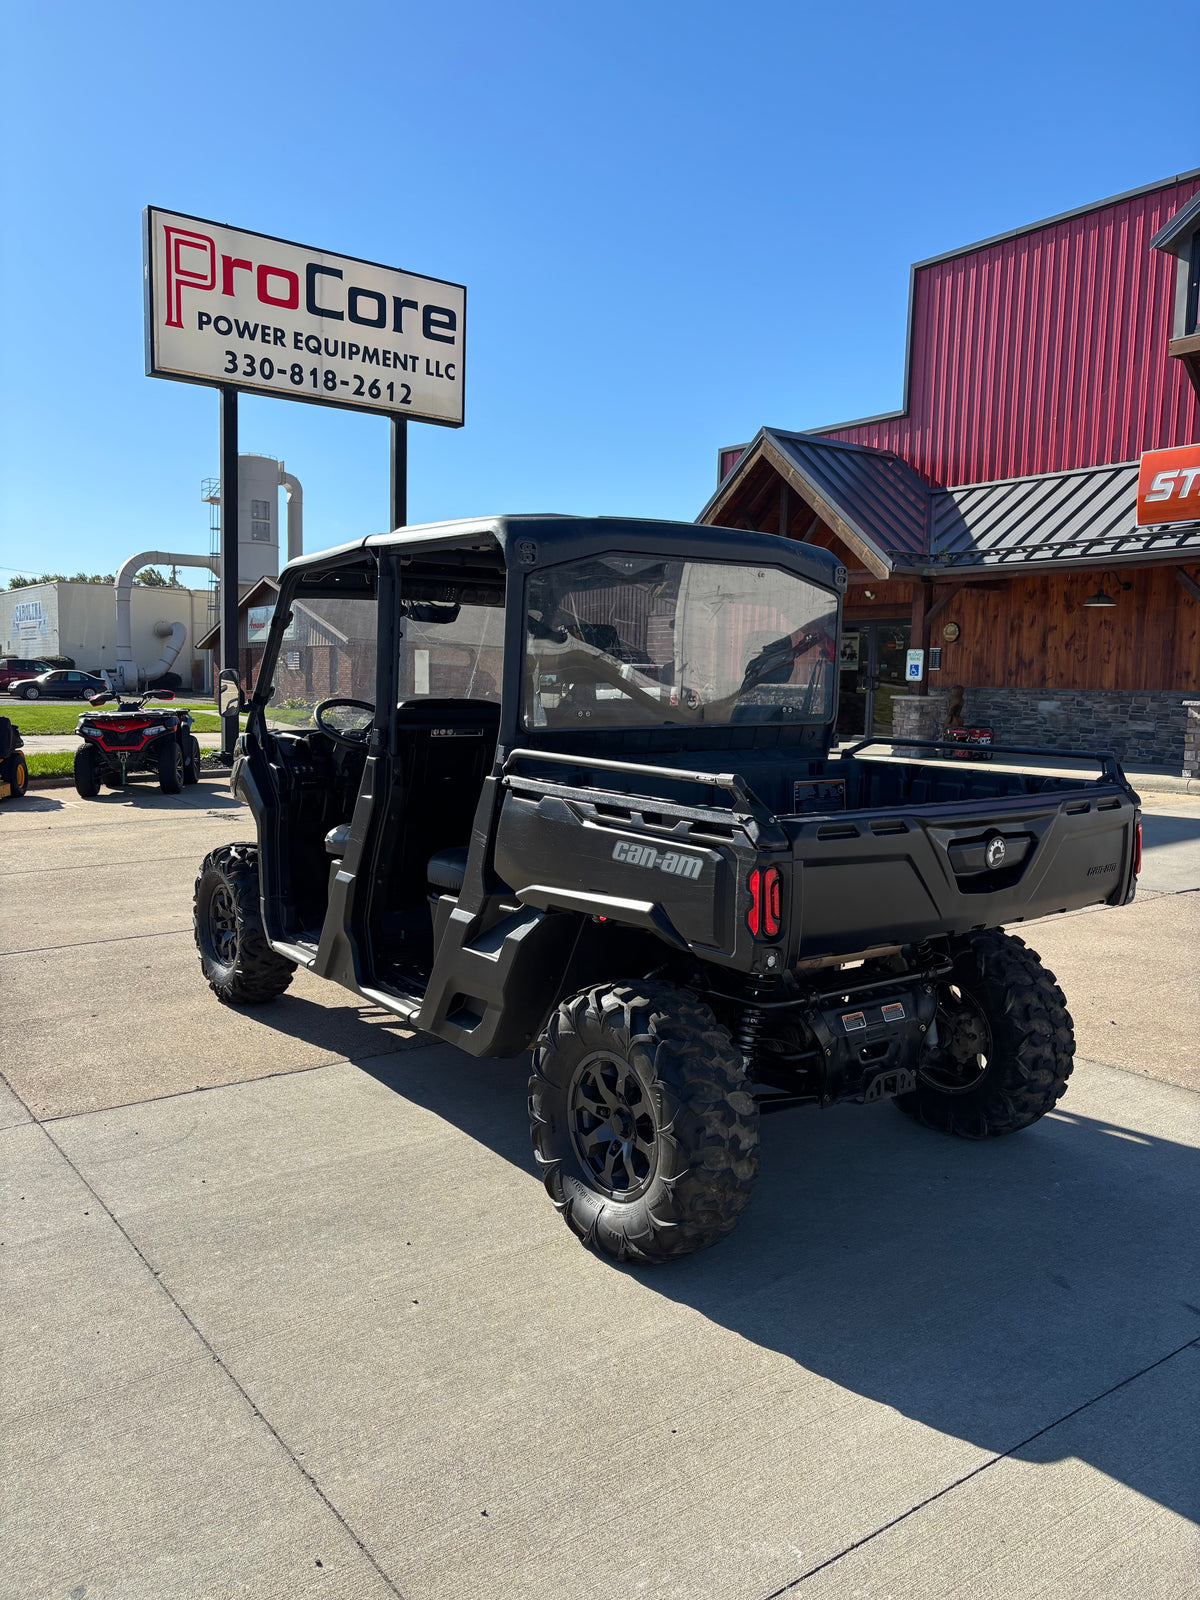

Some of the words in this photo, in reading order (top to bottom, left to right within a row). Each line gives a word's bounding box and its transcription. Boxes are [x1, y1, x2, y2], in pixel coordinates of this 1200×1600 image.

[162, 225, 457, 345] ProCore
[197, 311, 287, 348] POWER
[293, 331, 419, 373] EQUIPMENT
[425, 358, 456, 381] LLC
[223, 350, 412, 405] 330-818-2612
[1144, 466, 1200, 502] ST
[612, 840, 704, 880] can-am
